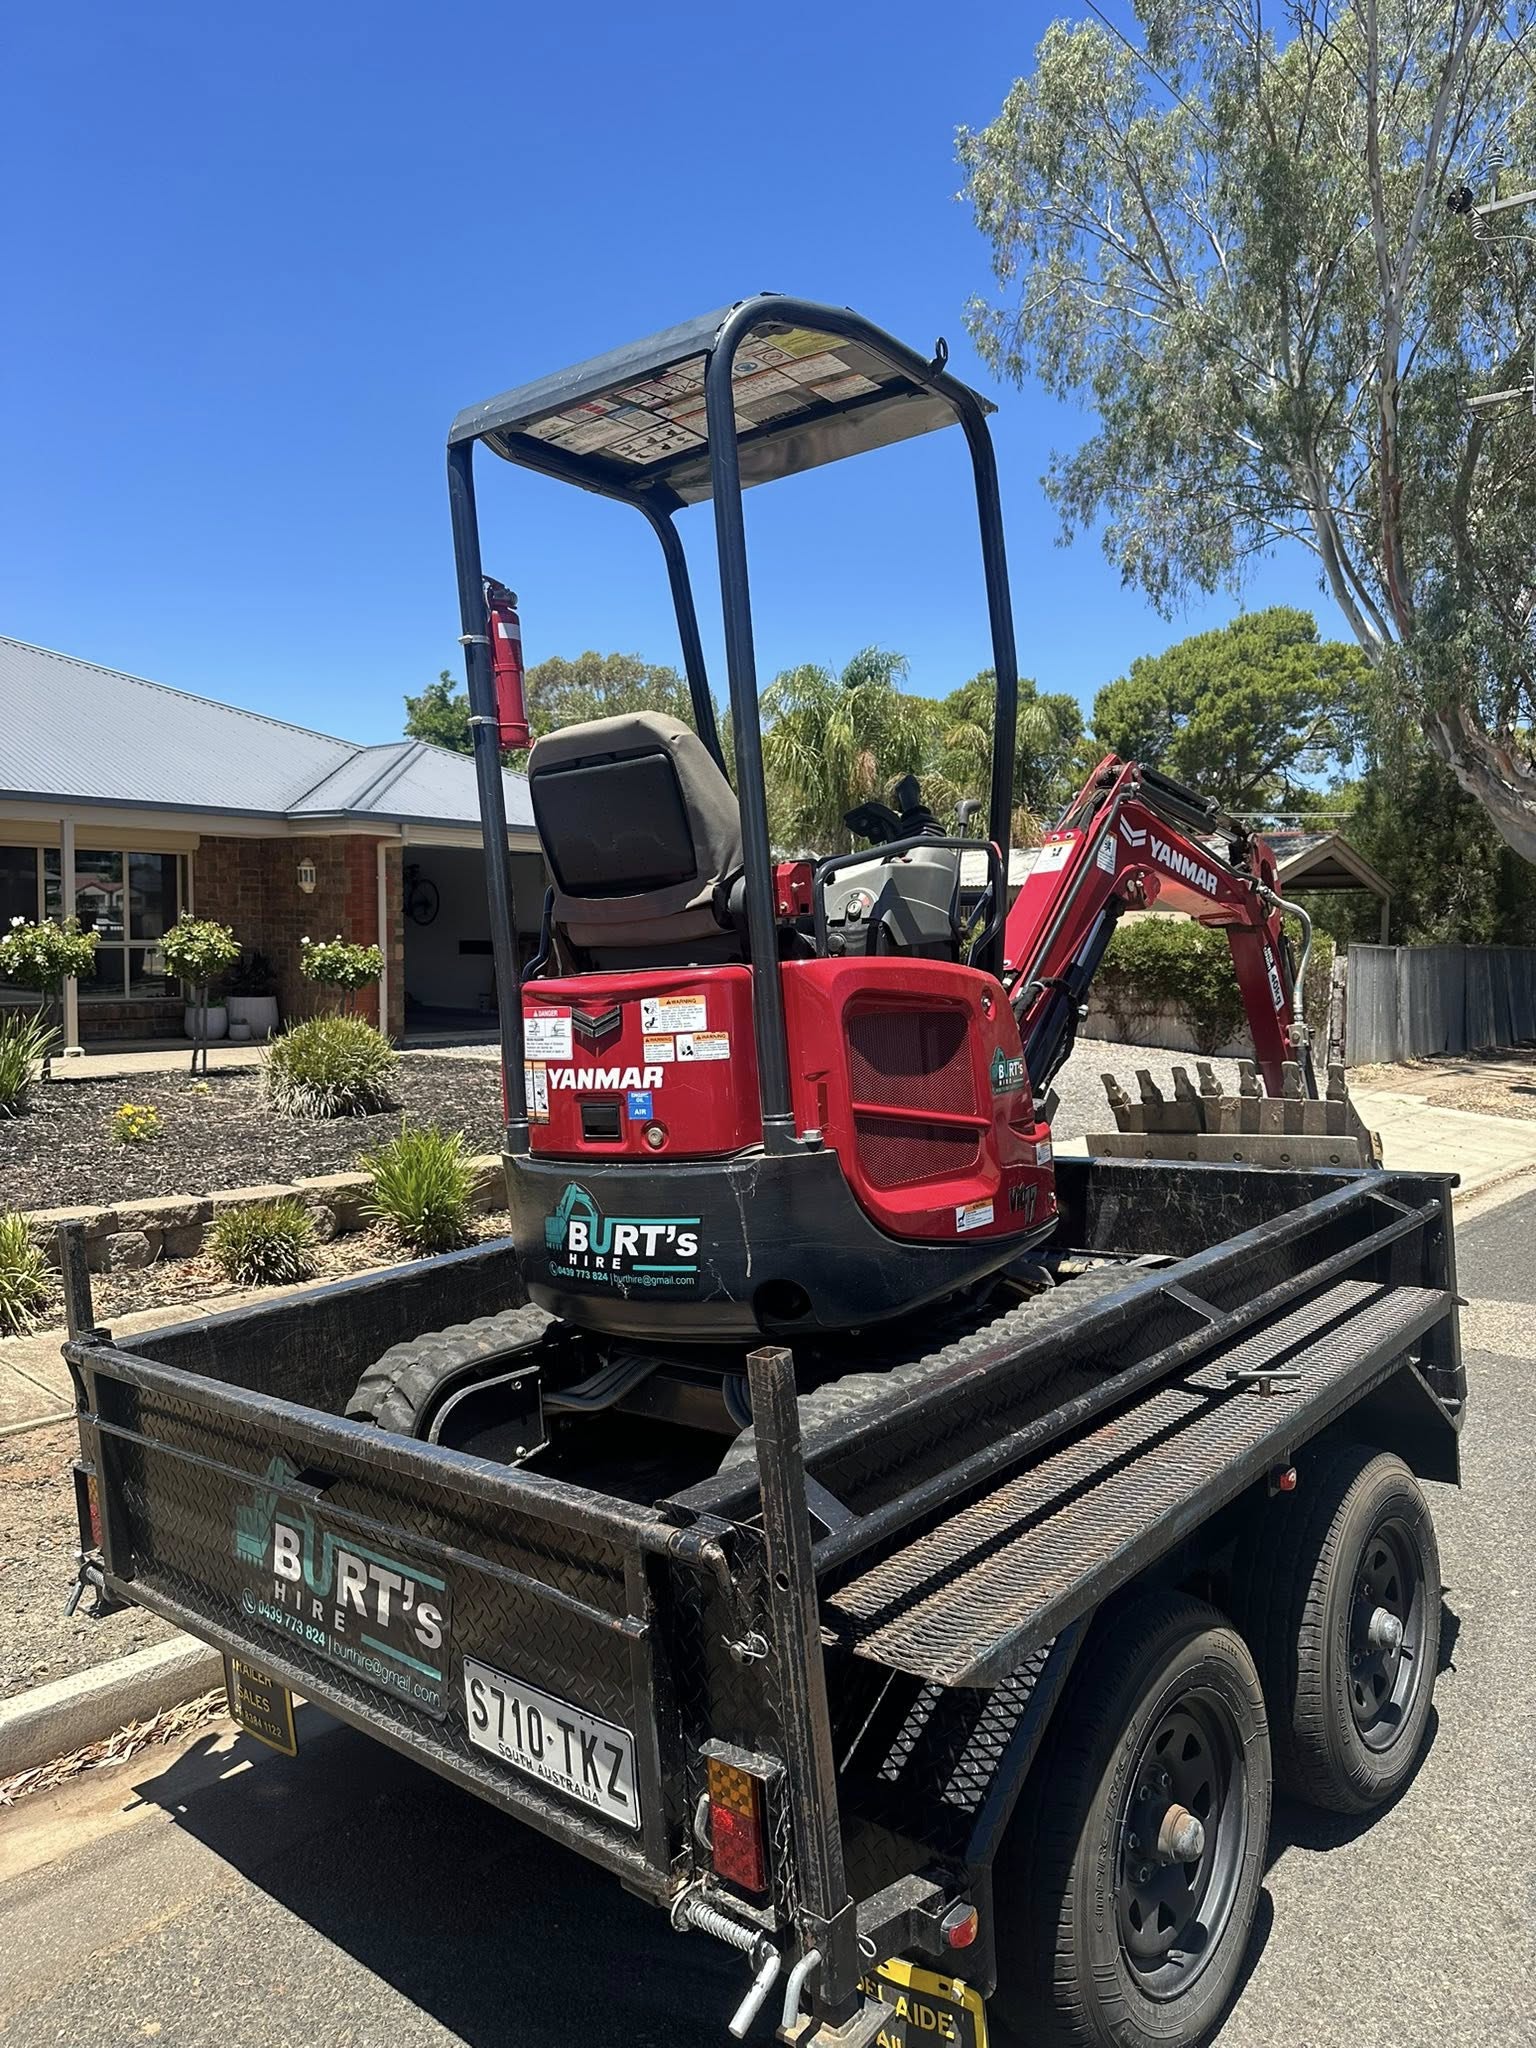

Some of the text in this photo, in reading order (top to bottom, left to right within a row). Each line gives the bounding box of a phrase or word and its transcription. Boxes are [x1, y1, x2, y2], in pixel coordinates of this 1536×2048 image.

[1150, 835, 1218, 895] YANMAR
[547, 1066, 664, 1090] YANMAR
[634, 1108, 647, 1116] AIR
[568, 1253, 622, 1270] HIRE
[557, 1265, 575, 1278] 0439
[576, 1269, 591, 1279] 773
[592, 1271, 609, 1282] 824
[613, 1273, 695, 1287] burthire@gmail.com
[274, 1580, 345, 1633] HIRE
[258, 1600, 283, 1625] 0439
[284, 1613, 304, 1636] 773
[306, 1624, 326, 1647] 824
[333, 1640, 441, 1707] burthire@gmail.com
[237, 1684, 271, 1713] SALES
[264, 1721, 282, 1738] 1122
[499, 1742, 601, 1806] SOUTH AUSTRALIA
